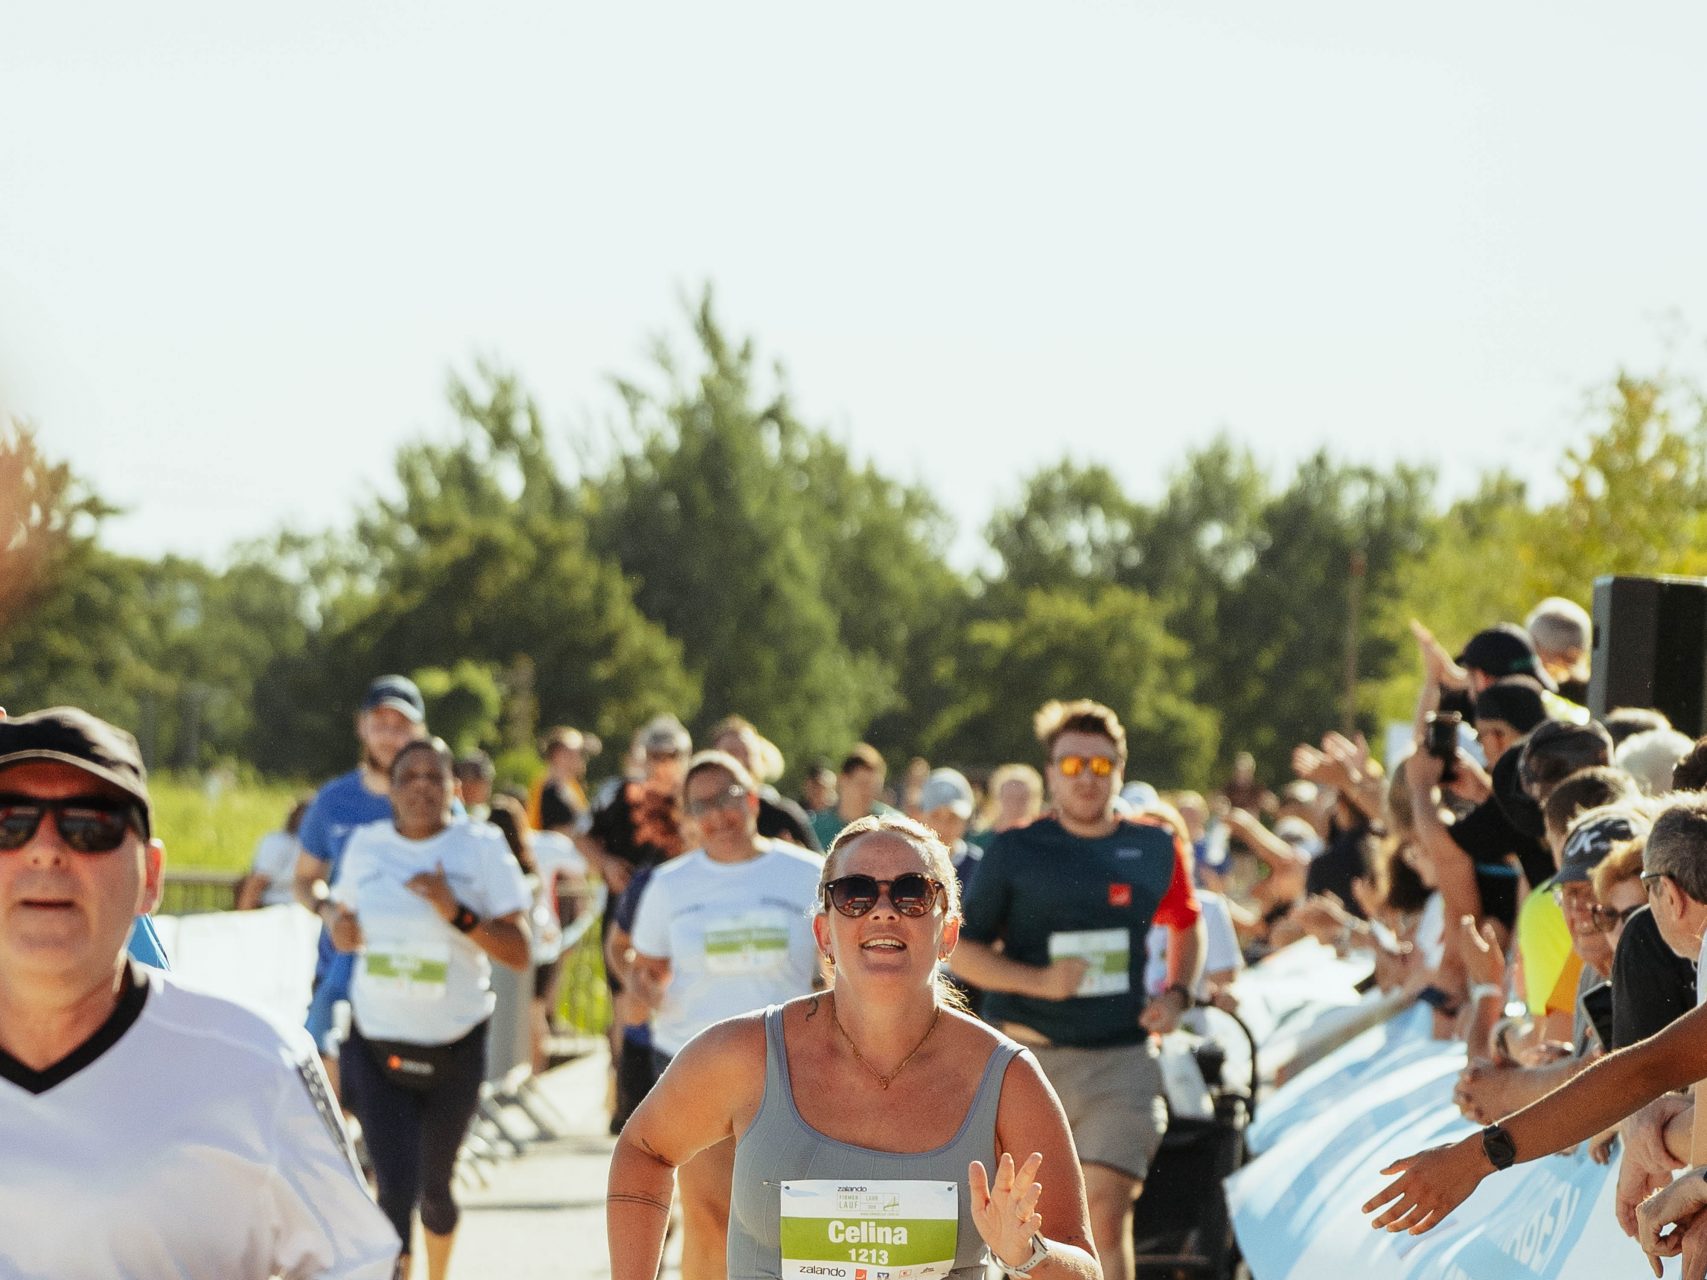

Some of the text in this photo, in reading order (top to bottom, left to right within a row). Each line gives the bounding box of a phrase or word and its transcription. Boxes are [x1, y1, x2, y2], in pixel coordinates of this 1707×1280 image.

[839, 1201, 858, 1209] LAUF
[828, 1220, 908, 1245] Celina
[848, 1248, 889, 1265] 1213
[799, 1265, 846, 1278] zalando
